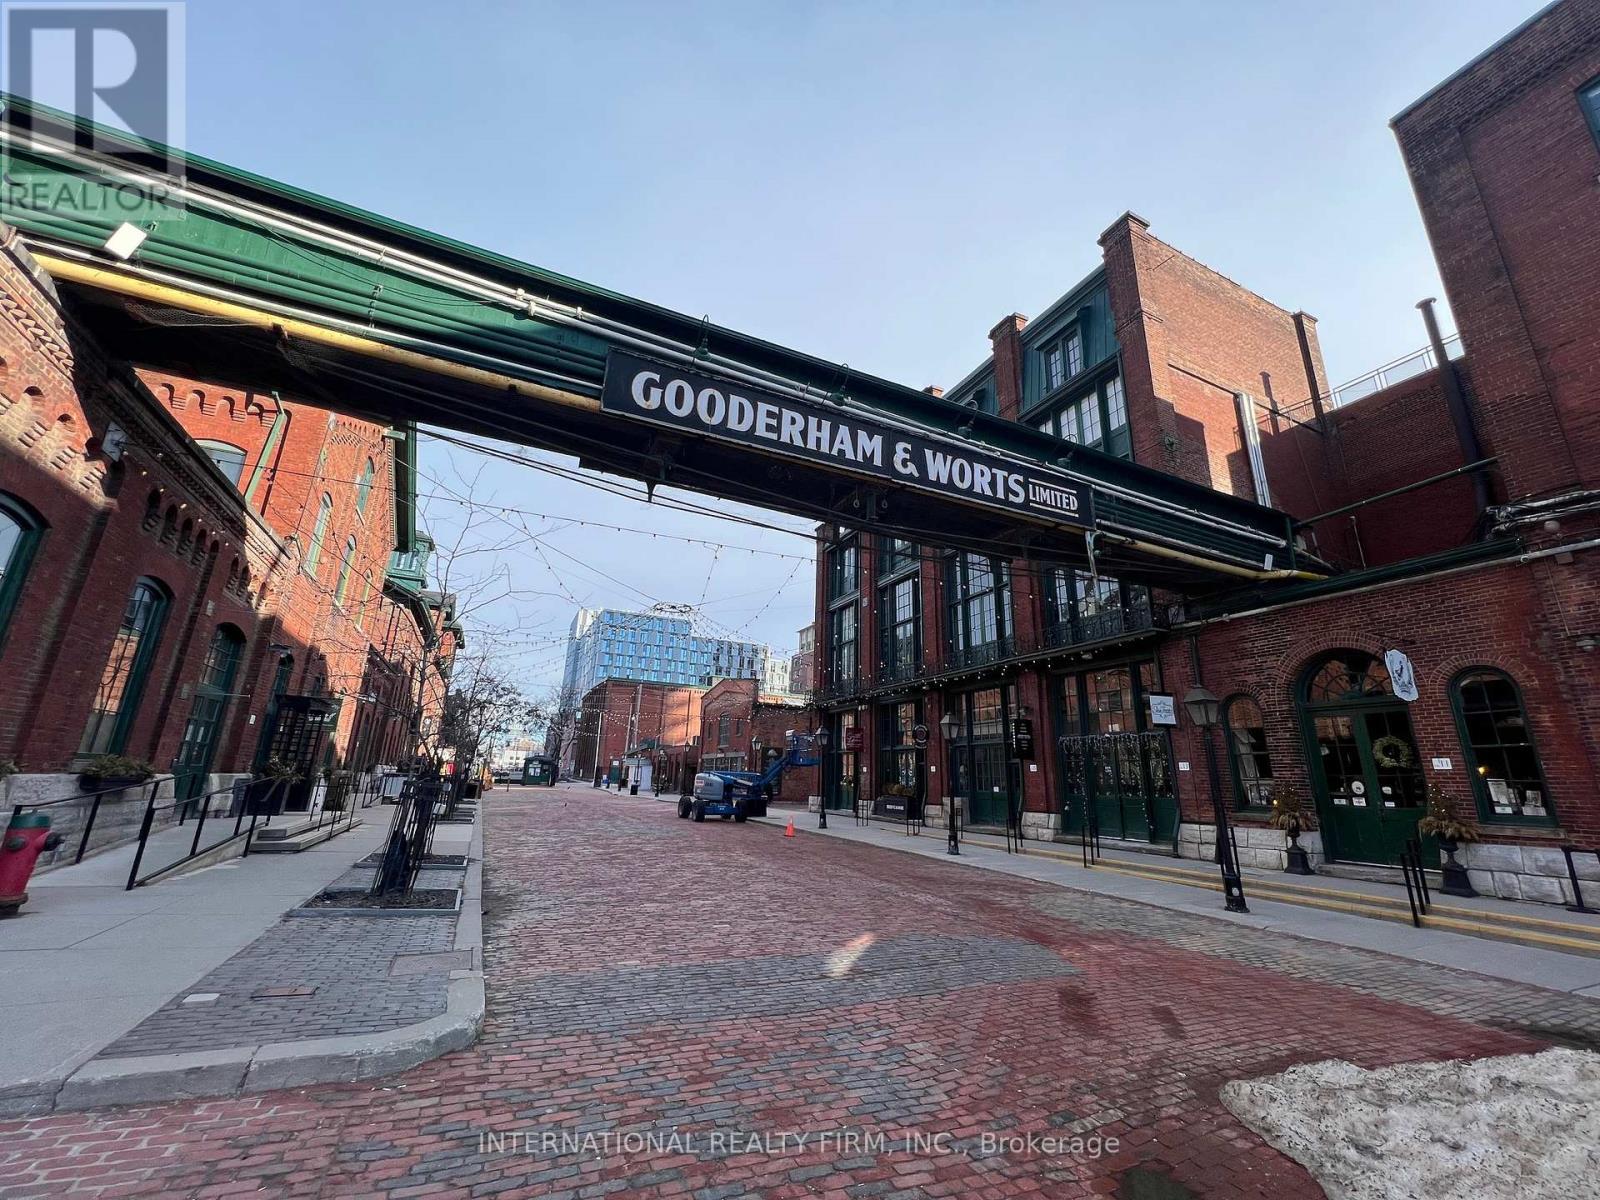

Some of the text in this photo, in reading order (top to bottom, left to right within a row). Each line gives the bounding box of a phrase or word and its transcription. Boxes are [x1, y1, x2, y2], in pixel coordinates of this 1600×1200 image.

[630, 371, 1079, 511] GOODERHAM & WORTS LIMITED
